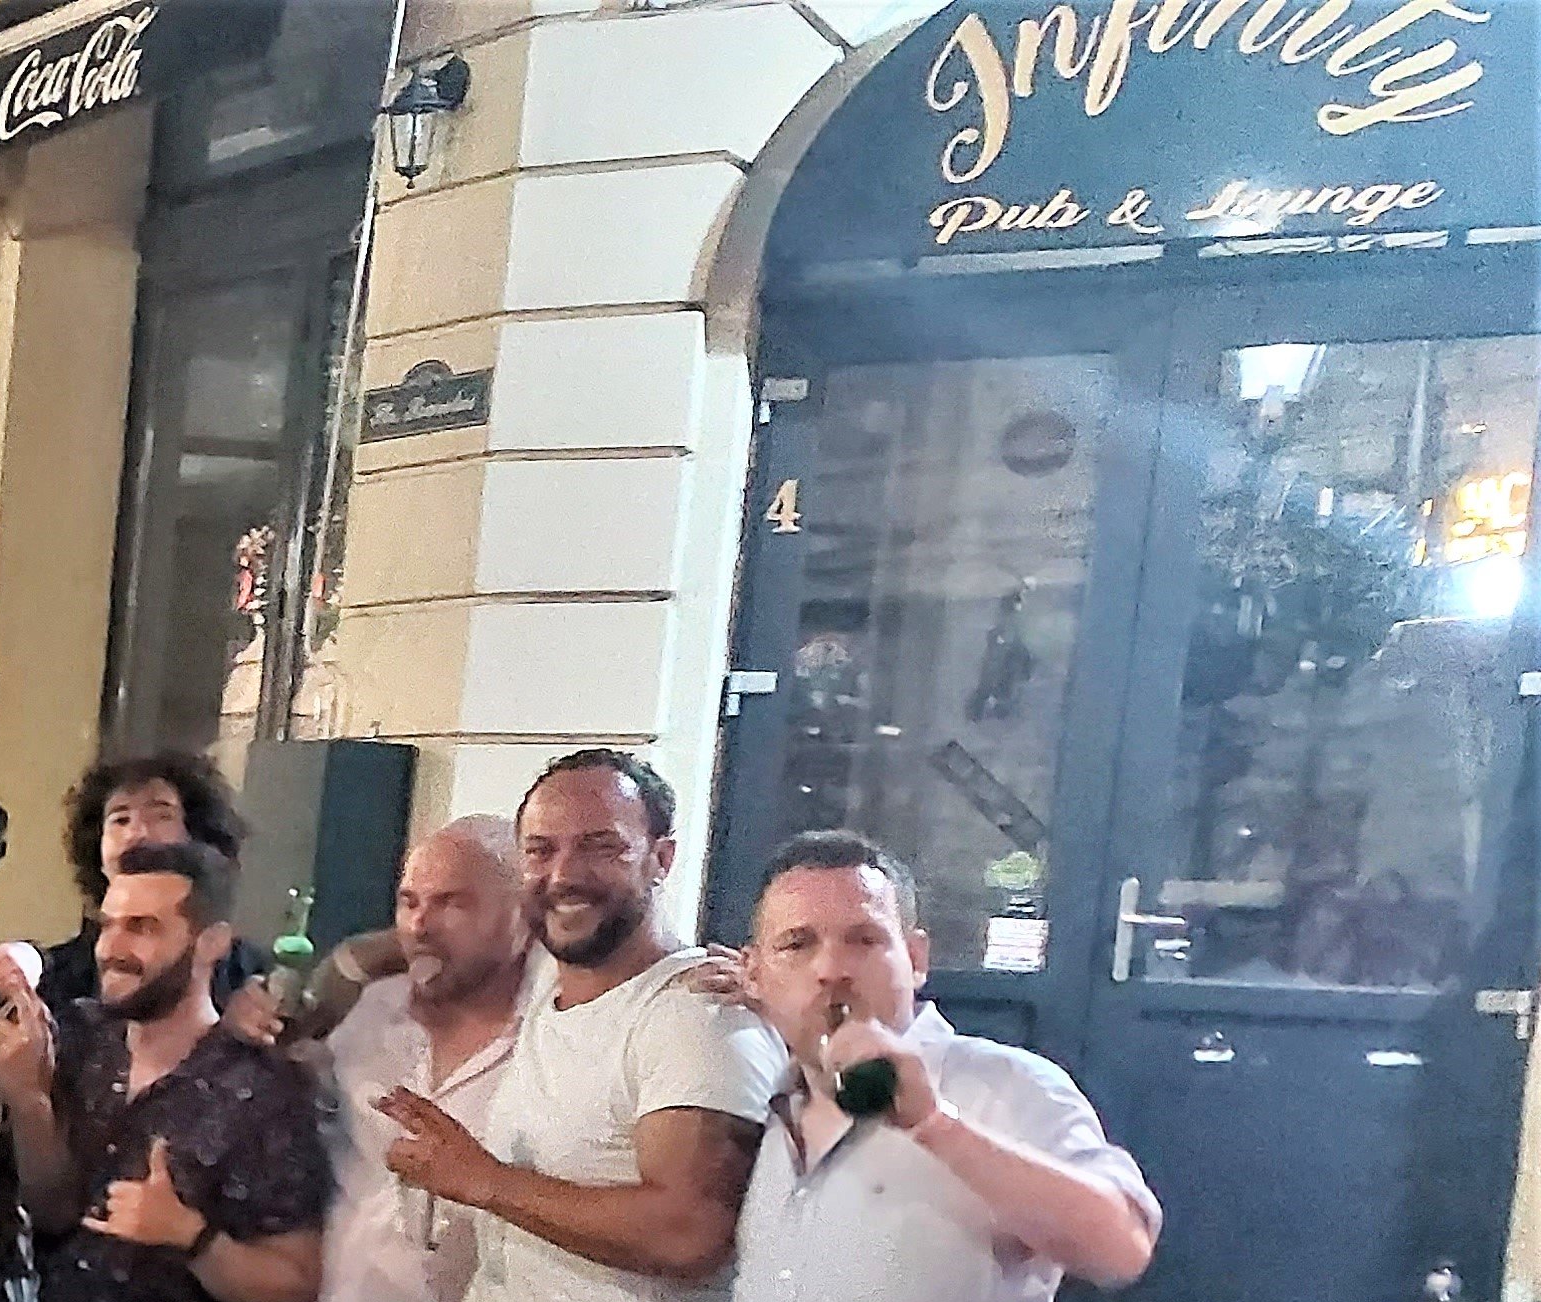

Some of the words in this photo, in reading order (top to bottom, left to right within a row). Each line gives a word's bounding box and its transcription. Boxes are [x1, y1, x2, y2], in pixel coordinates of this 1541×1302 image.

[929, 189, 1090, 245] Pub
[1106, 187, 1164, 235] &
[1184, 178, 1446, 227] Lounge
[763, 478, 803, 534] 4
